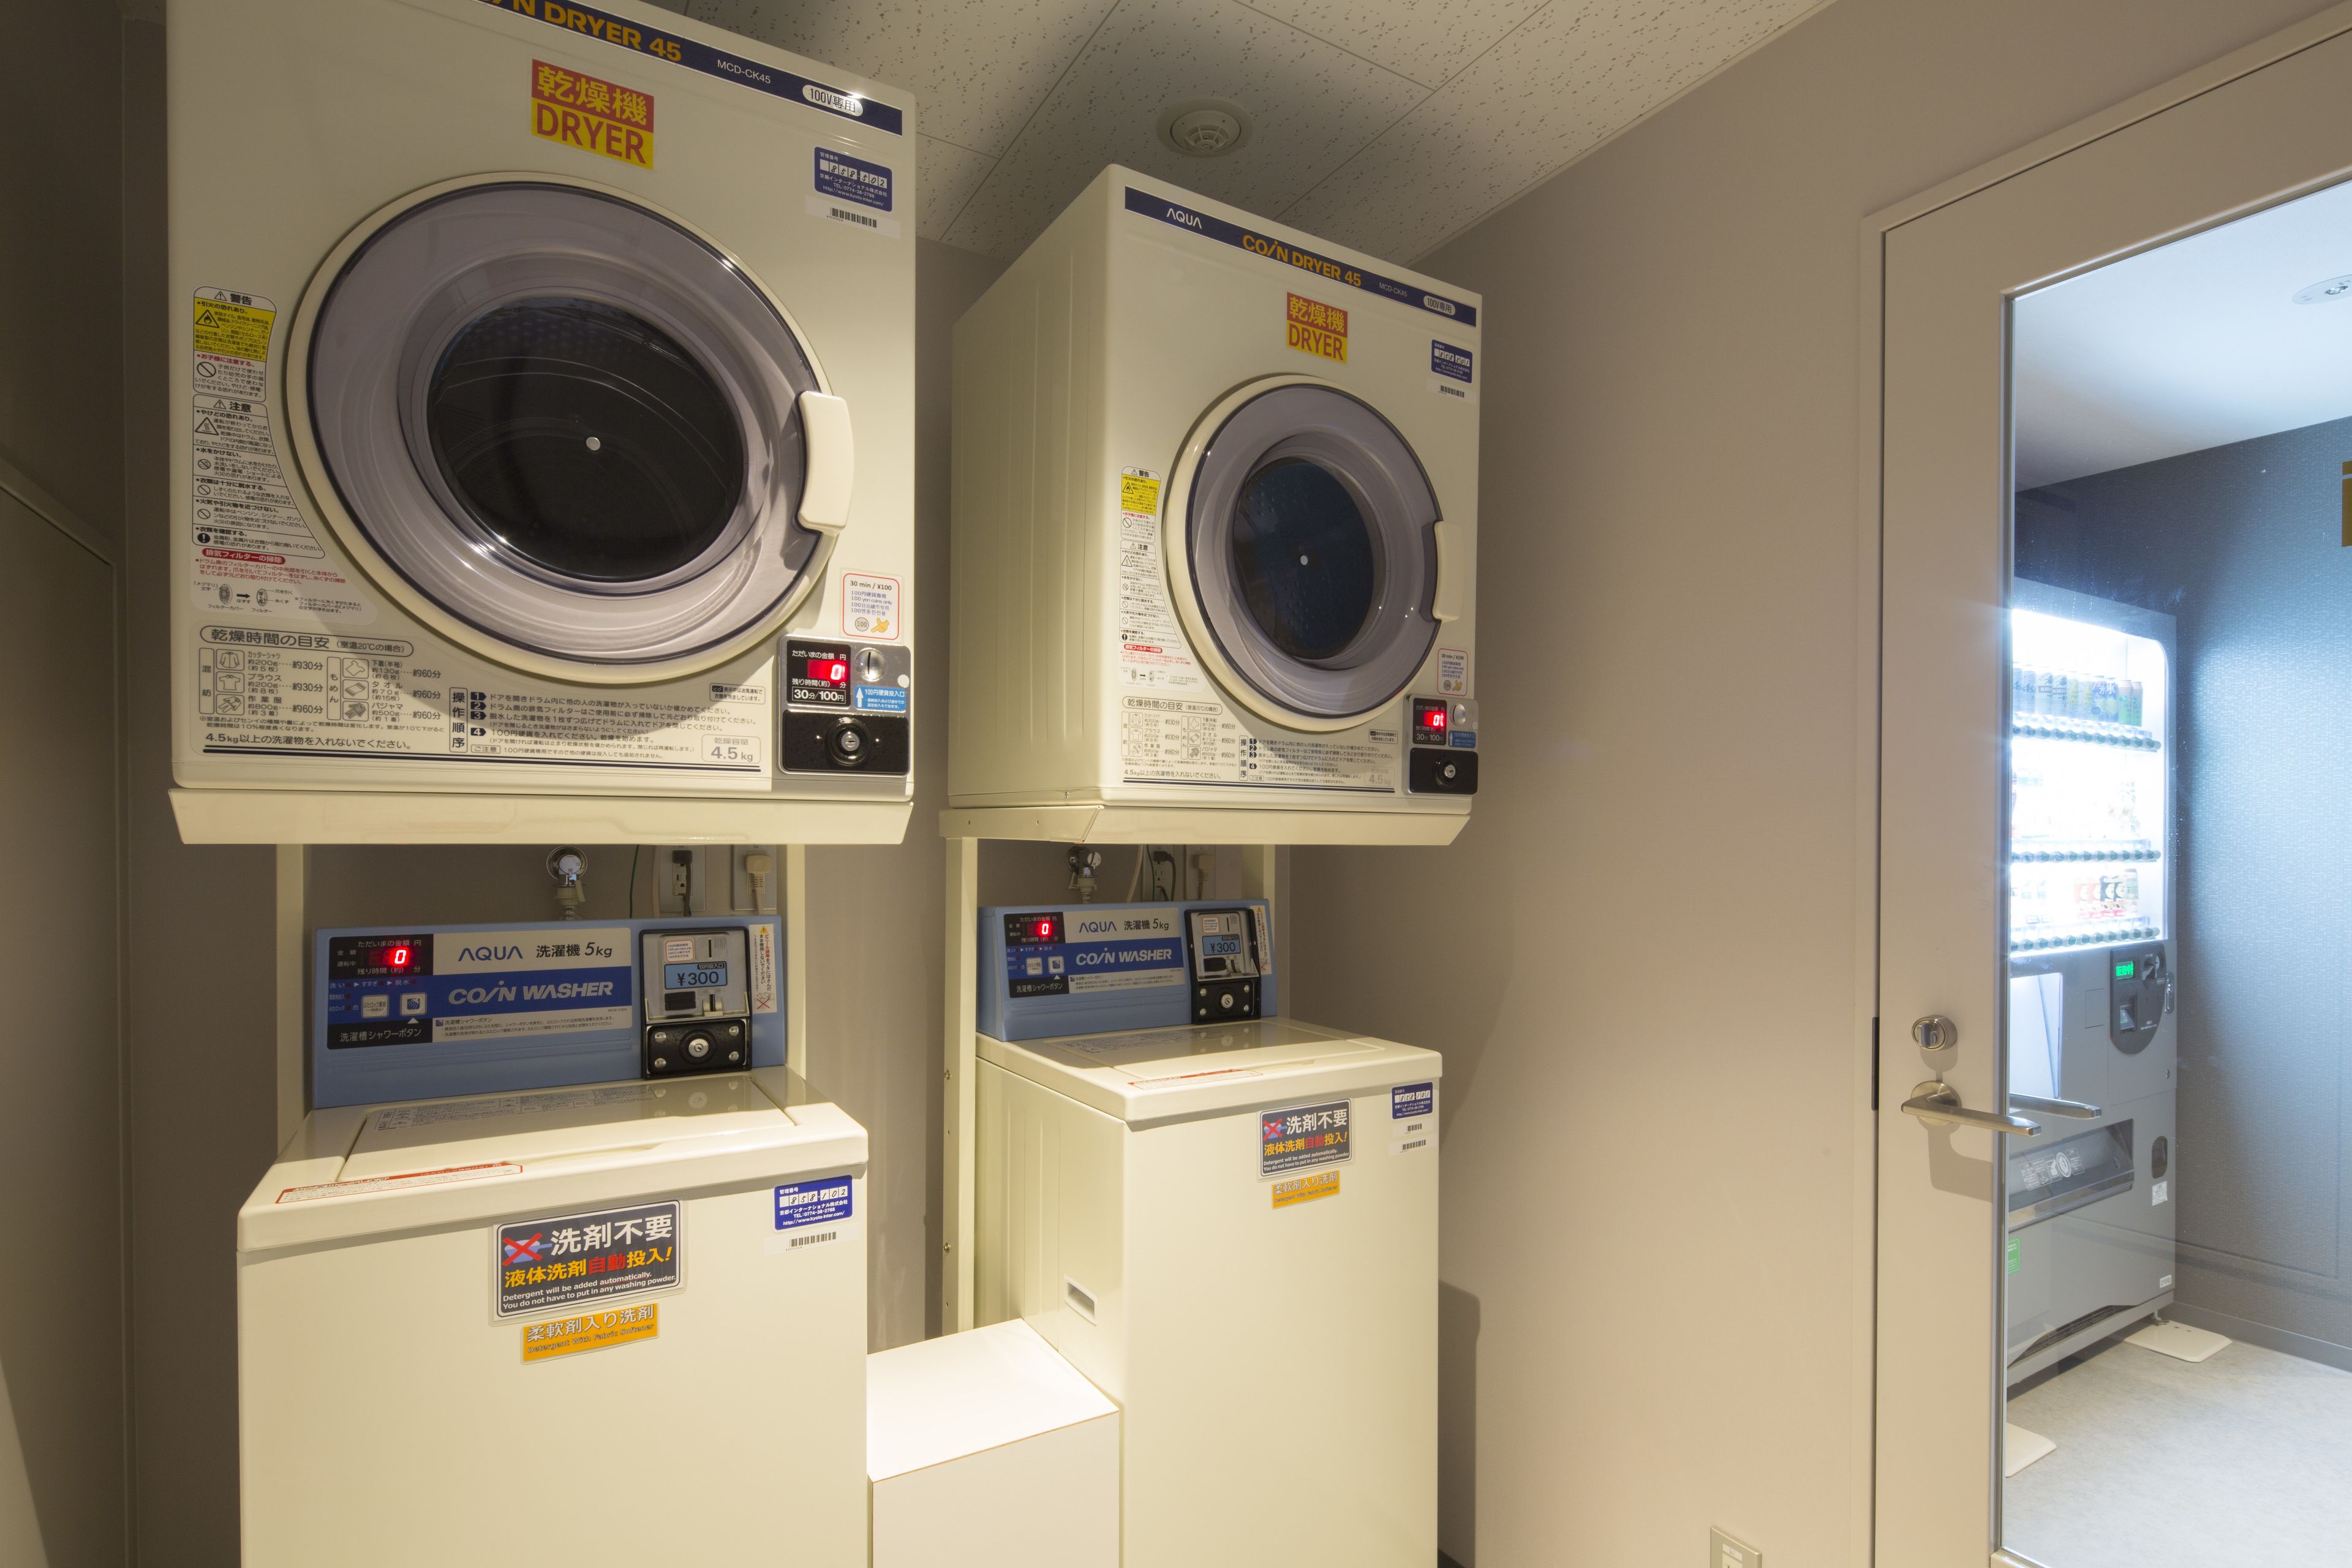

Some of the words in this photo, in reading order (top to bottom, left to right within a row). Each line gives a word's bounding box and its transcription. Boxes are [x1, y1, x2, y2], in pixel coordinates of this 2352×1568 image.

[545, 1, 641, 50] DRYER
[649, 38, 682, 61] 45
[717, 59, 771, 83] MCD-CK45
[538, 66, 646, 126] 乾燥機
[810, 88, 856, 113] 100V専用
[537, 103, 646, 164] DRYER
[1167, 208, 1202, 230] AQUA
[1292, 251, 1341, 281] DRYER
[1344, 270, 1361, 287] 45
[1379, 282, 1407, 297] MCD-CK45
[201, 301, 247, 314] 引火の恐れあり。
[230, 293, 252, 306] 警告
[1427, 298, 1452, 314] 100V専用
[1289, 296, 1344, 333] 乾燥機
[1289, 323, 1343, 361] DRYER
[201, 354, 254, 367] お子様に注意する。
[229, 401, 252, 413] 注意
[201, 410, 253, 422] やけどの恐れあり。
[200, 447, 242, 458] 水をかけない。
[200, 478, 266, 491] 衣類は十分に脱水する。
[206, 549, 282, 564] 排気フィルターの掃除
[211, 628, 330, 649] 乾燥時間の目安
[792, 650, 834, 660] ただいまの金額
[1128, 698, 1183, 710] 乾燥時間の目安
[205, 733, 411, 750] 4.5kg以上の洗濯物を入れないでください。
[714, 737, 748, 745] 乾燥容量
[711, 746, 738, 760] 4.5
[741, 752, 753, 762] kg
[1042, 923, 1049, 935] 0
[1079, 921, 1117, 933] AQUA
[1124, 920, 1150, 930] 洗濯機
[1153, 919, 1169, 930] 5kg
[458, 946, 523, 962] AQUA
[536, 944, 580, 958] 洗濯機
[584, 942, 612, 958] 5kg
[1118, 949, 1172, 962] WASHER
[1210, 942, 1235, 953] ¥300
[394, 949, 406, 964] 0
[677, 971, 719, 986] ¥300
[522, 981, 613, 1000] WASHER
[1016, 983, 1063, 992] 洗濯槽シャワーボタン
[340, 1028, 421, 1042] 洗濯槽シャワーボタン
[1286, 1109, 1348, 1135] 洗剤不要
[1311, 1148, 1338, 1158] automatically.
[1274, 1171, 1337, 1196] 柔軟剤入り洗剤
[779, 1199, 848, 1216] 京都インターナショナル株式会社
[793, 1207, 835, 1218] TEL:0774-38-2788
[783, 1210, 845, 1226] http://www.kyoto-inter.com/
[551, 1214, 673, 1256] 洗剤不要
[505, 1246, 673, 1288] 液体洗剤自動投入!
[503, 1289, 544, 1302] Detergent
[574, 1280, 598, 1289] added
[600, 1272, 652, 1285] automatically.
[546, 1294, 565, 1302] have
[576, 1289, 589, 1299] put
[600, 1286, 613, 1294] any
[615, 1280, 647, 1292] washing
[647, 1275, 676, 1287] powder.
[527, 1304, 654, 1343] 柔軟剤入り洗剤
[528, 1340, 570, 1354] Detergent
[572, 1335, 591, 1345] With
[594, 1330, 618, 1341] Fabric
[620, 1324, 654, 1336] Softener
